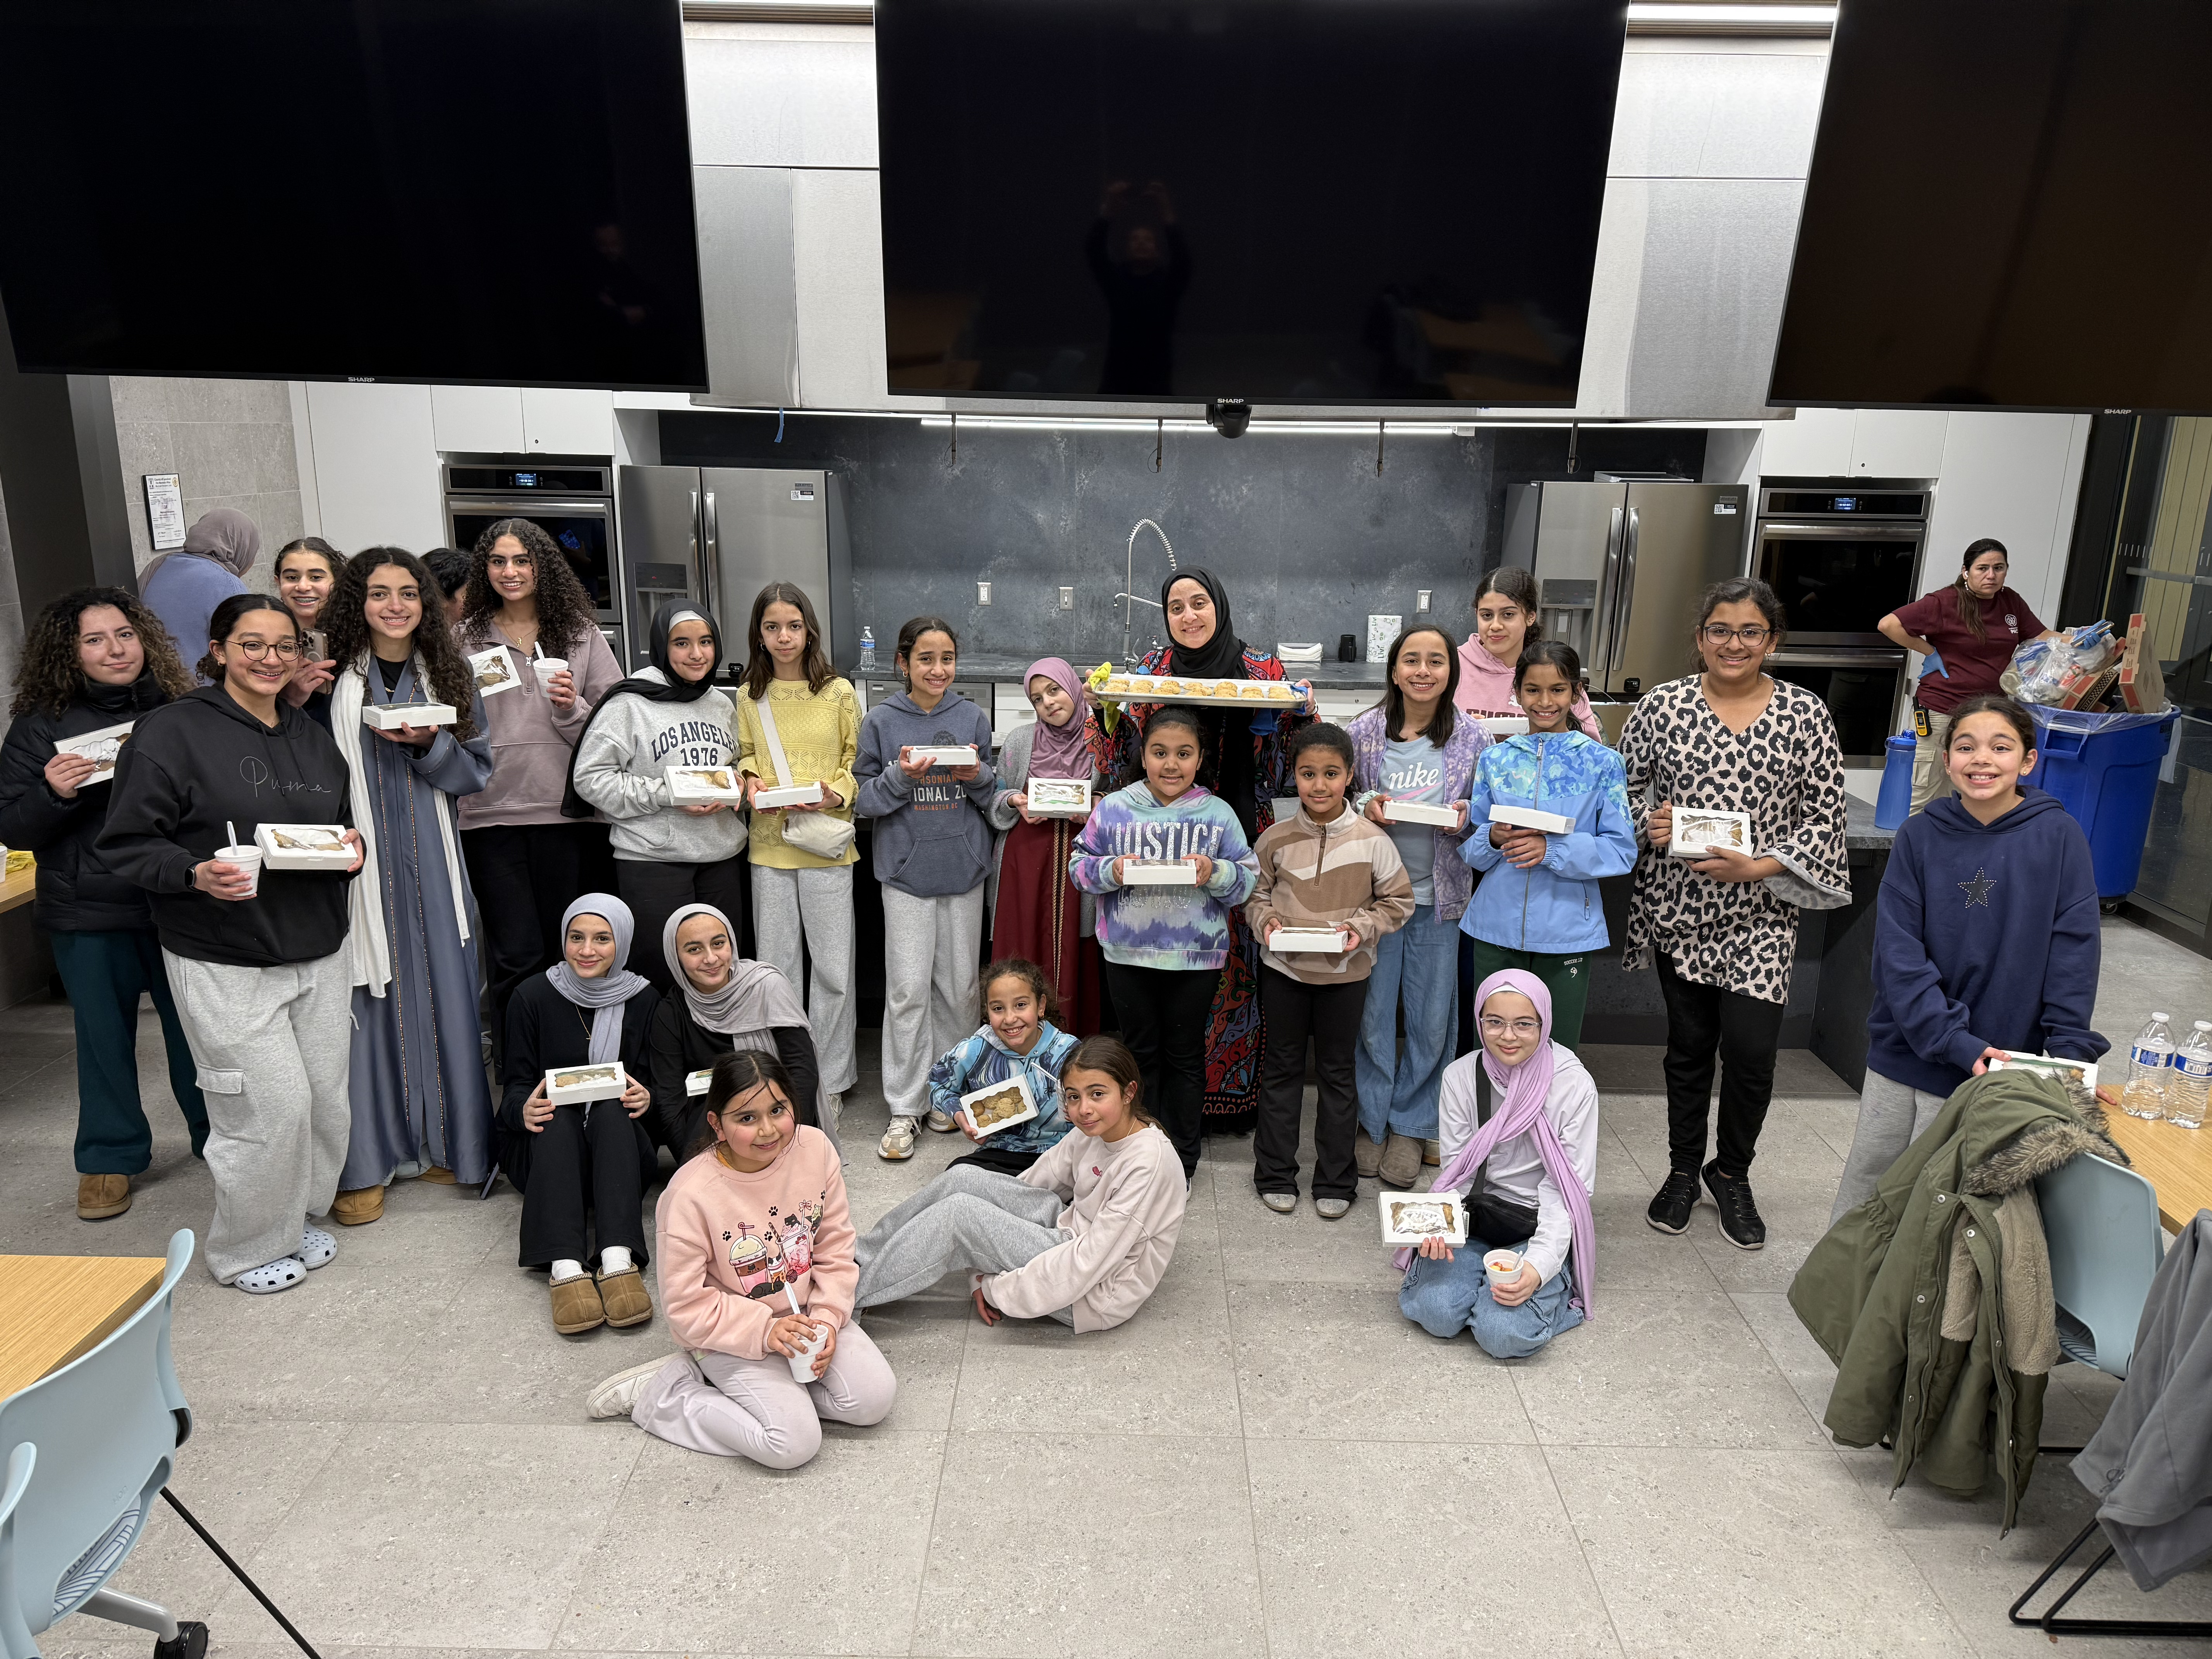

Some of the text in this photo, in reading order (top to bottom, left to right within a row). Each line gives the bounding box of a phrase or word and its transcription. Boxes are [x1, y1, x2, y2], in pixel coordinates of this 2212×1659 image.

[651, 726, 678, 763] LOS
[680, 747, 718, 766] 1976
[240, 756, 331, 798] Puma
[920, 775, 957, 784] HSONIAN
[1388, 762, 1439, 789] nike
[913, 787, 950, 802] IONAL
